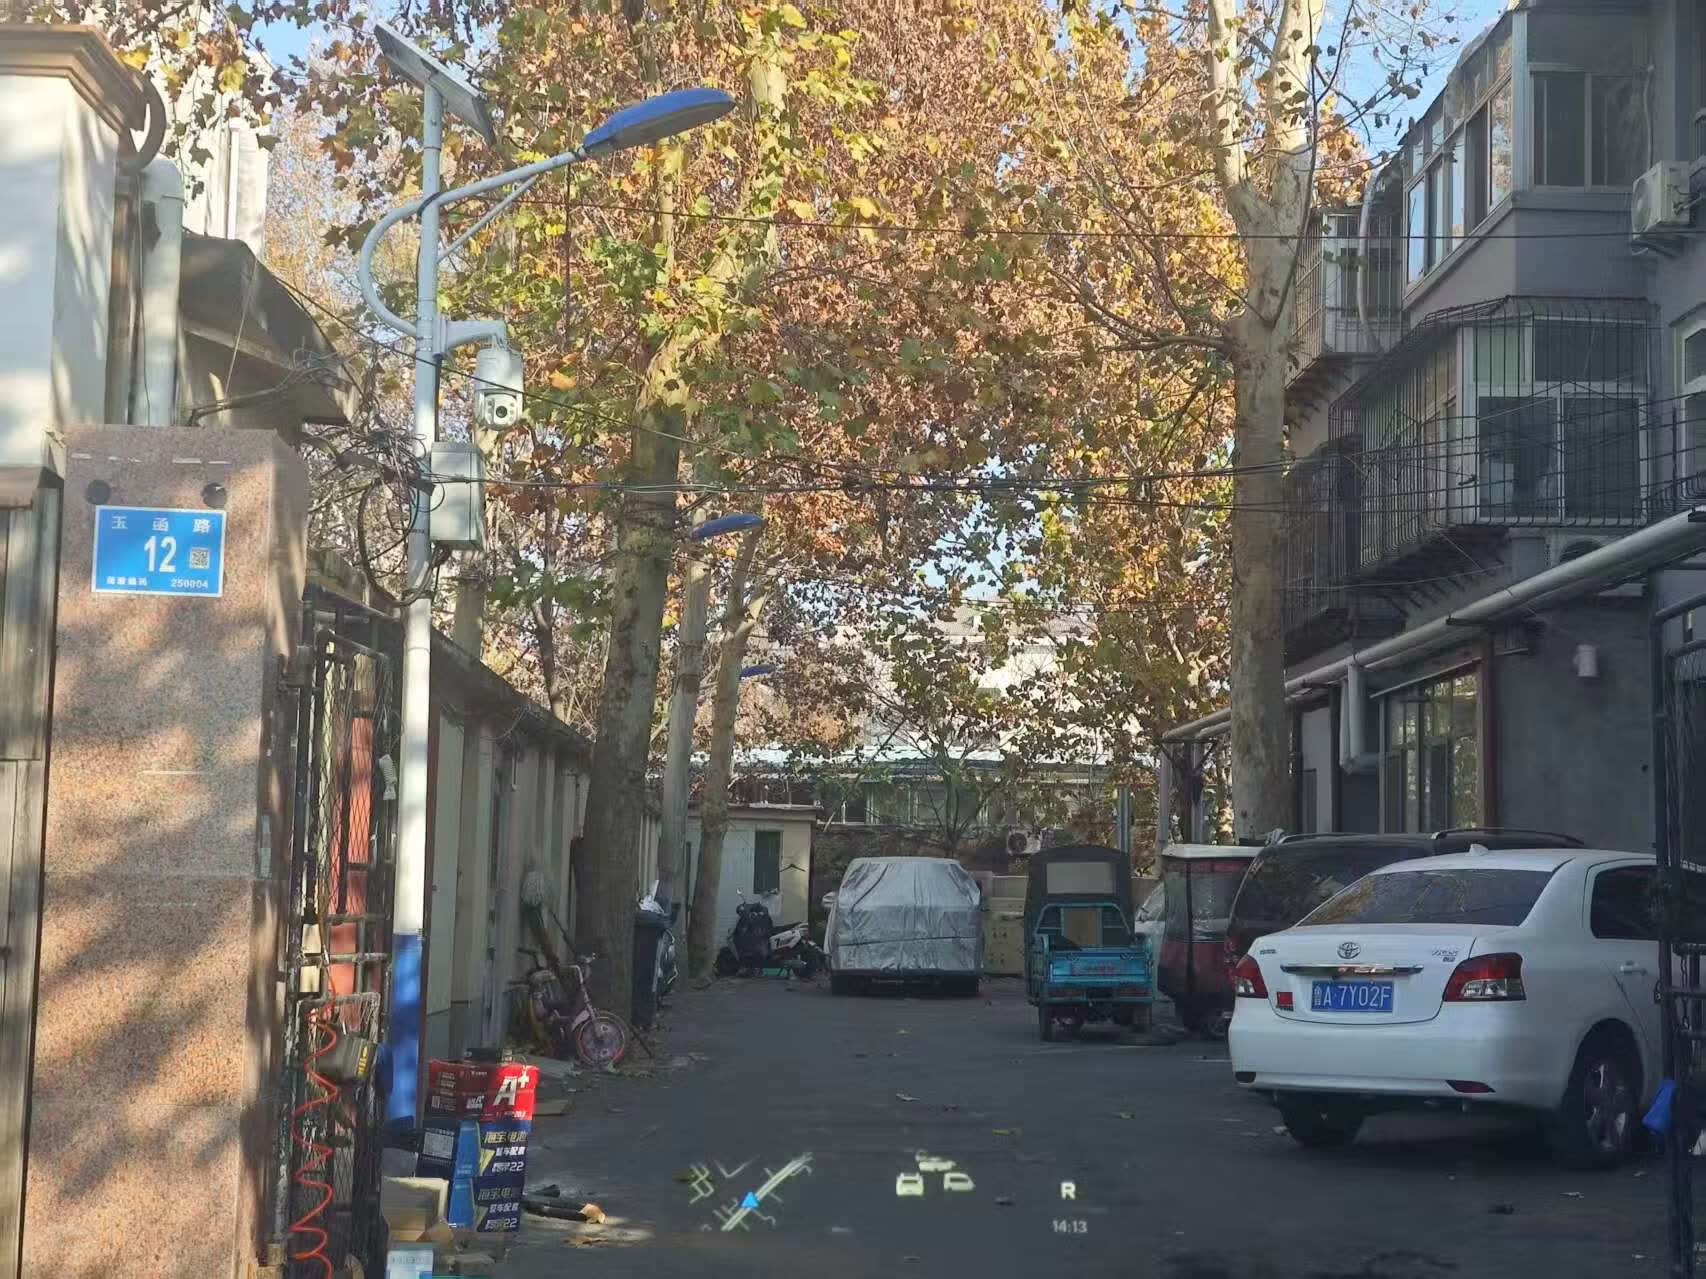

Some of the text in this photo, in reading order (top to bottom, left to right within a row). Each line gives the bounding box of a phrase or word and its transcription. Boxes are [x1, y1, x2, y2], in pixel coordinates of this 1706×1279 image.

[111, 515, 211, 533] 玉函路
[144, 535, 177, 573] 12
[170, 577, 209, 589] 250004
[492, 1073, 530, 1106] A+
[1061, 1181, 1077, 1199] R
[1052, 1220, 1089, 1235] 14:13
